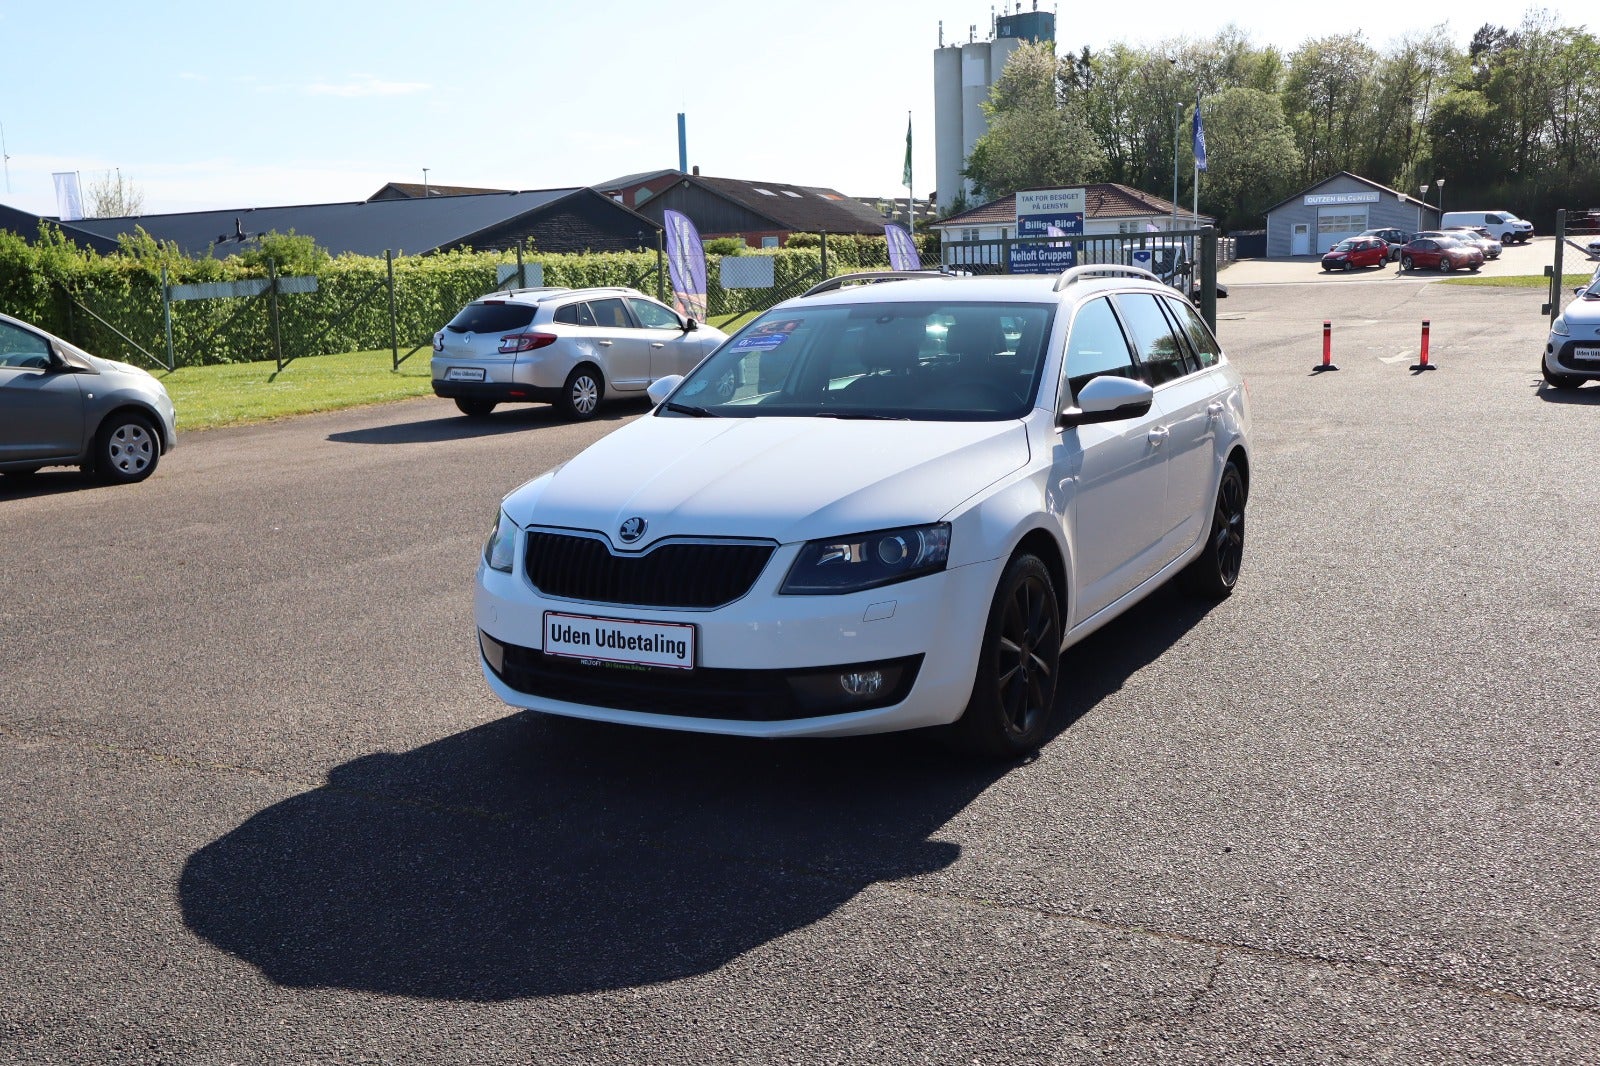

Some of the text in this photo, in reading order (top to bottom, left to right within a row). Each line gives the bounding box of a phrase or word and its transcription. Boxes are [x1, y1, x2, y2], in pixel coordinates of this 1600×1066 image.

[1055, 220, 1076, 228] Biler
[1011, 250, 1072, 261] Neltoft Gruppen
[551, 623, 686, 660] Uden Udbetaling
